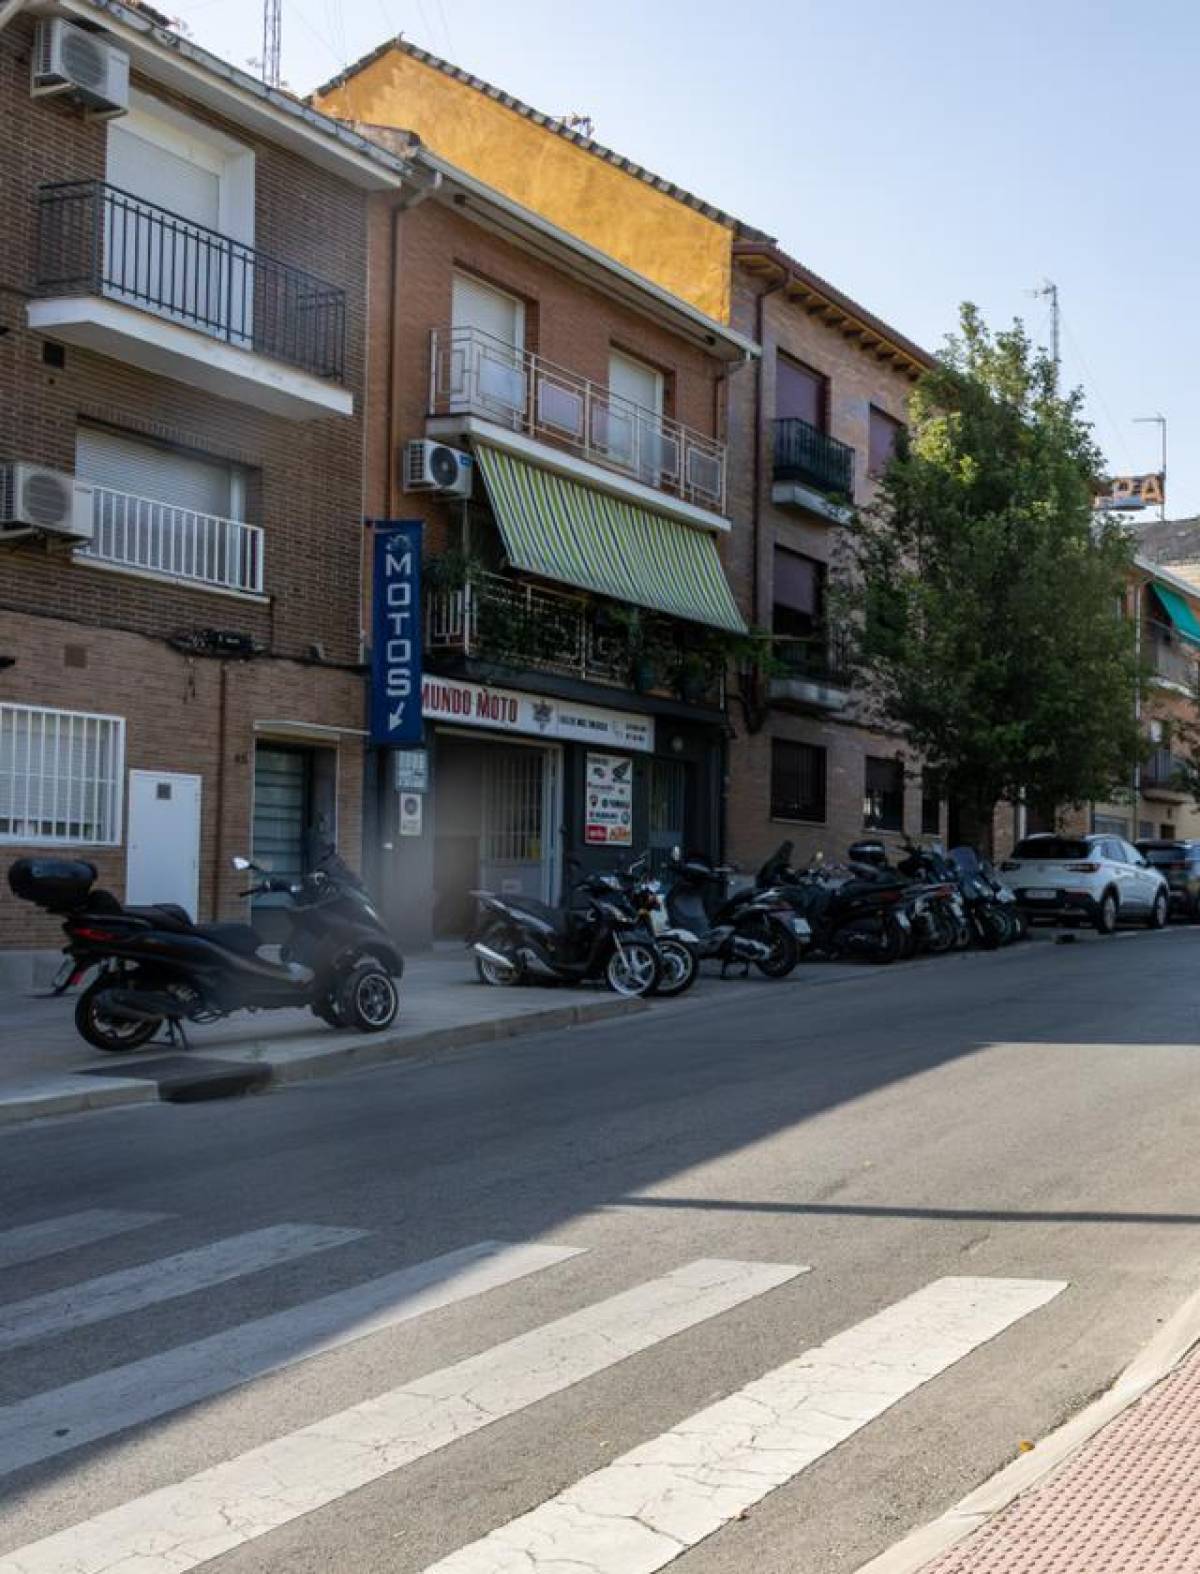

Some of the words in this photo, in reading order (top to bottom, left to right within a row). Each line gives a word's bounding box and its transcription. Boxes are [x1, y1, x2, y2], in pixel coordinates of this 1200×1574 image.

[385, 552, 412, 696] MOTOS
[422, 683, 472, 716] MUNDO
[476, 689, 518, 722] MOTO
